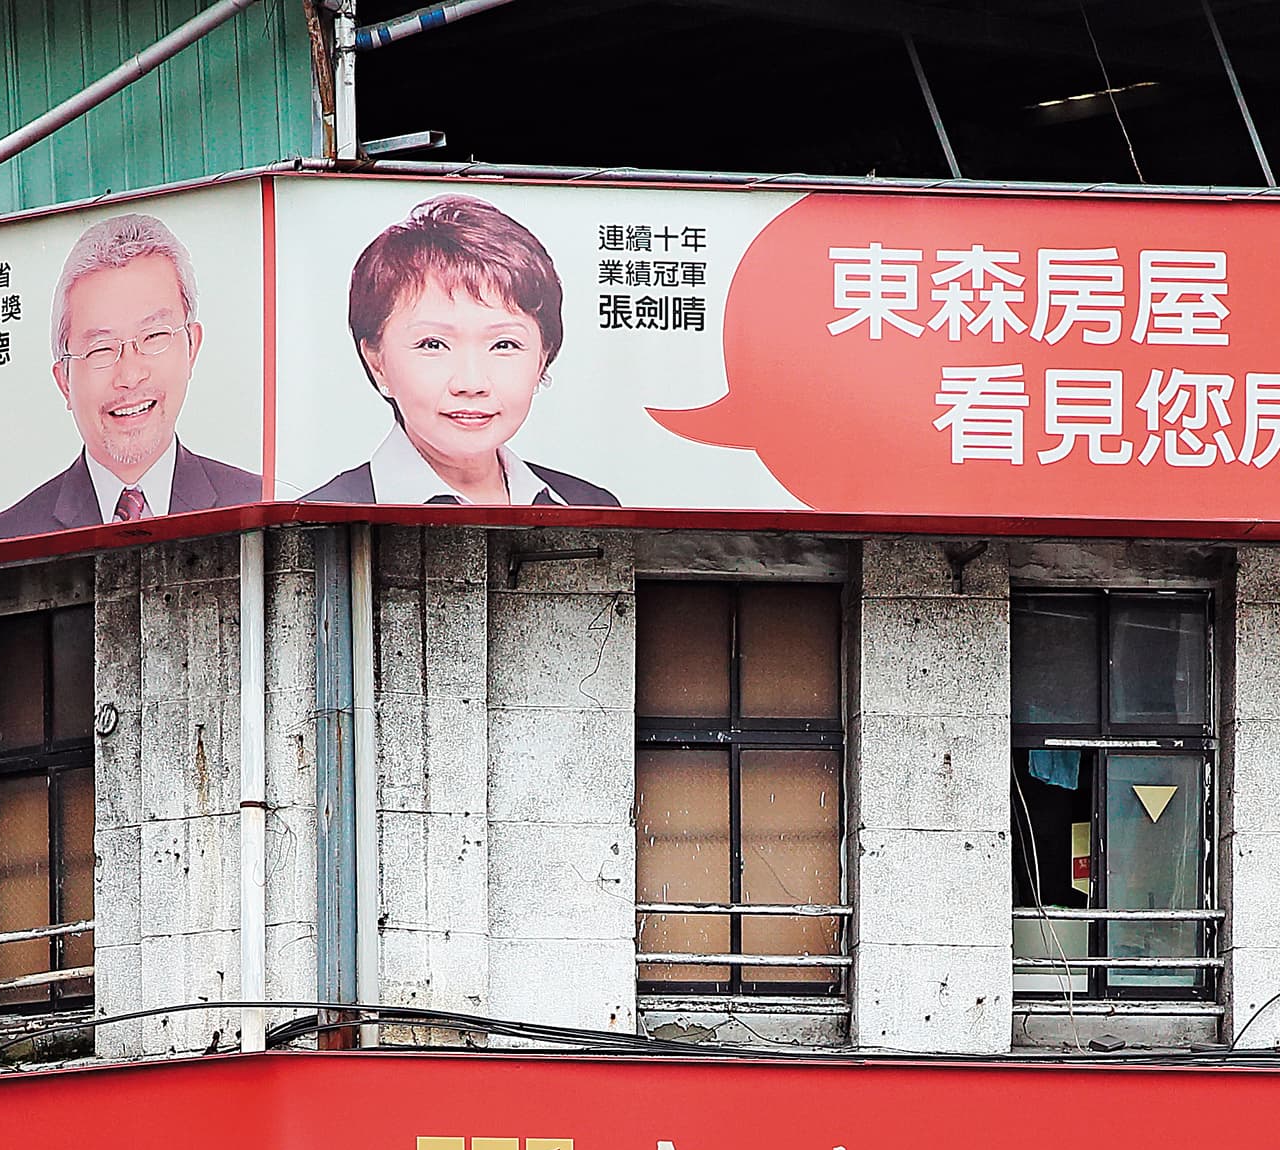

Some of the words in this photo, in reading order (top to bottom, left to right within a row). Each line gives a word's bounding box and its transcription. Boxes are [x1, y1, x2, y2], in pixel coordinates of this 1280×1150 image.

[597, 223, 708, 255] 連續十年
[597, 260, 708, 288] 業績冠軍
[825, 241, 1231, 347] 東森房屋
[598, 293, 708, 333] 張劍晴
